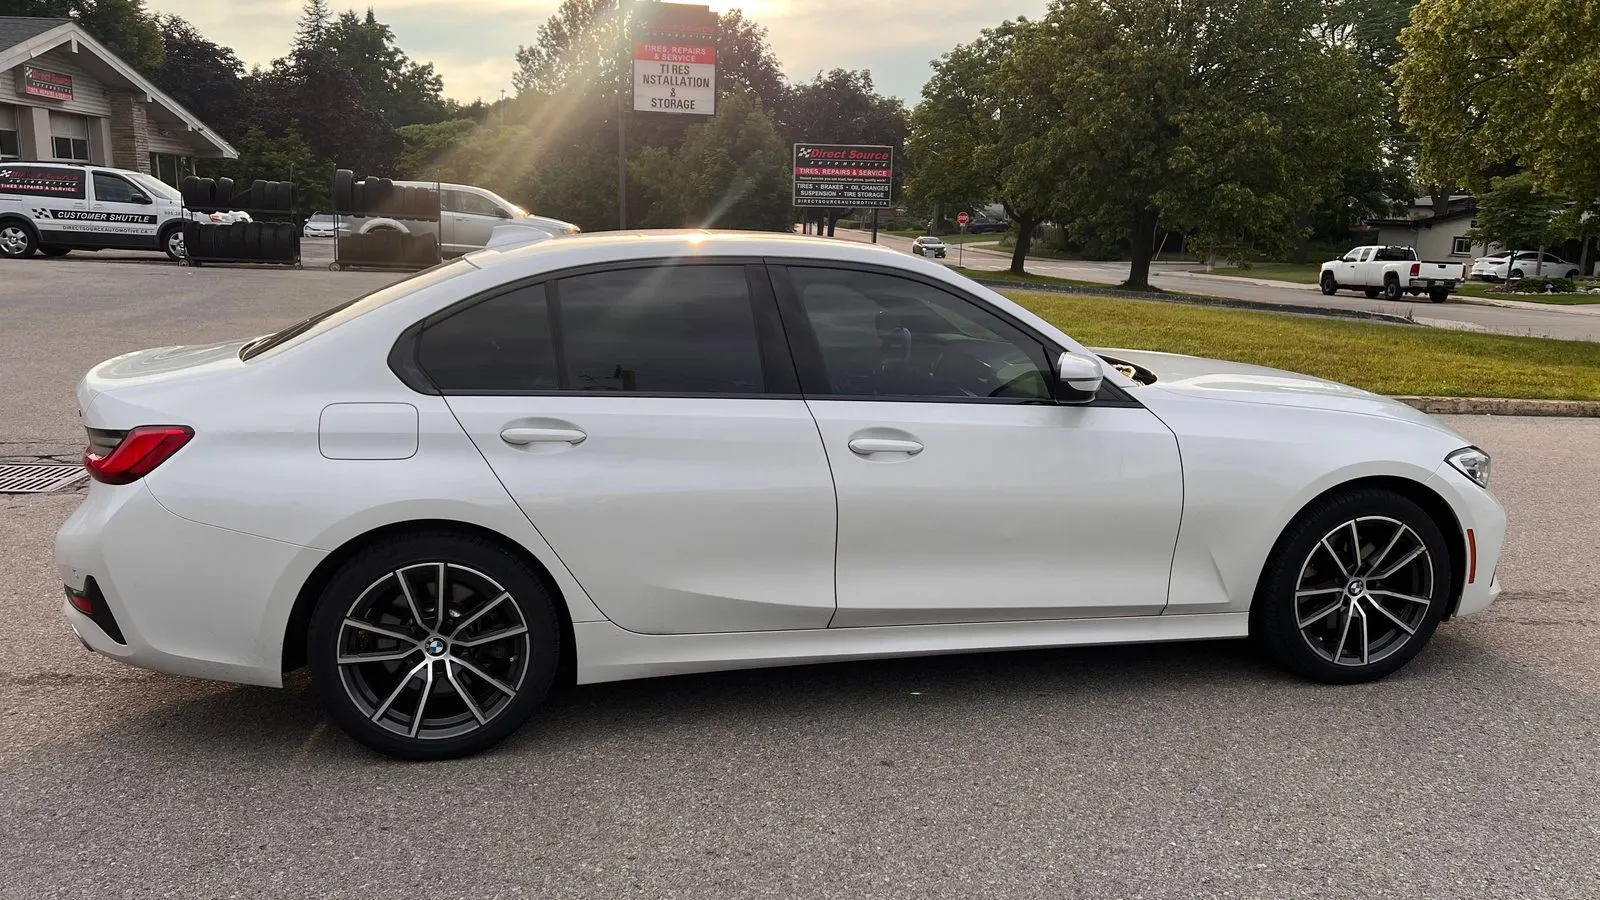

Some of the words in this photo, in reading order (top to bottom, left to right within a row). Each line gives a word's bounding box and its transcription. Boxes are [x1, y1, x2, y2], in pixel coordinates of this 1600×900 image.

[672, 46, 706, 55] REPAIRS
[662, 54, 696, 62] SERVICE
[643, 74, 709, 88] NSTALLATION
[670, 87, 676, 98] &
[651, 97, 695, 110] STORAGE
[811, 149, 845, 159] Direct
[848, 150, 889, 160] Source
[822, 168, 851, 176] REPAIRS
[57, 211, 107, 221] CUSTOMER
[109, 214, 150, 223] SHUTTLE
